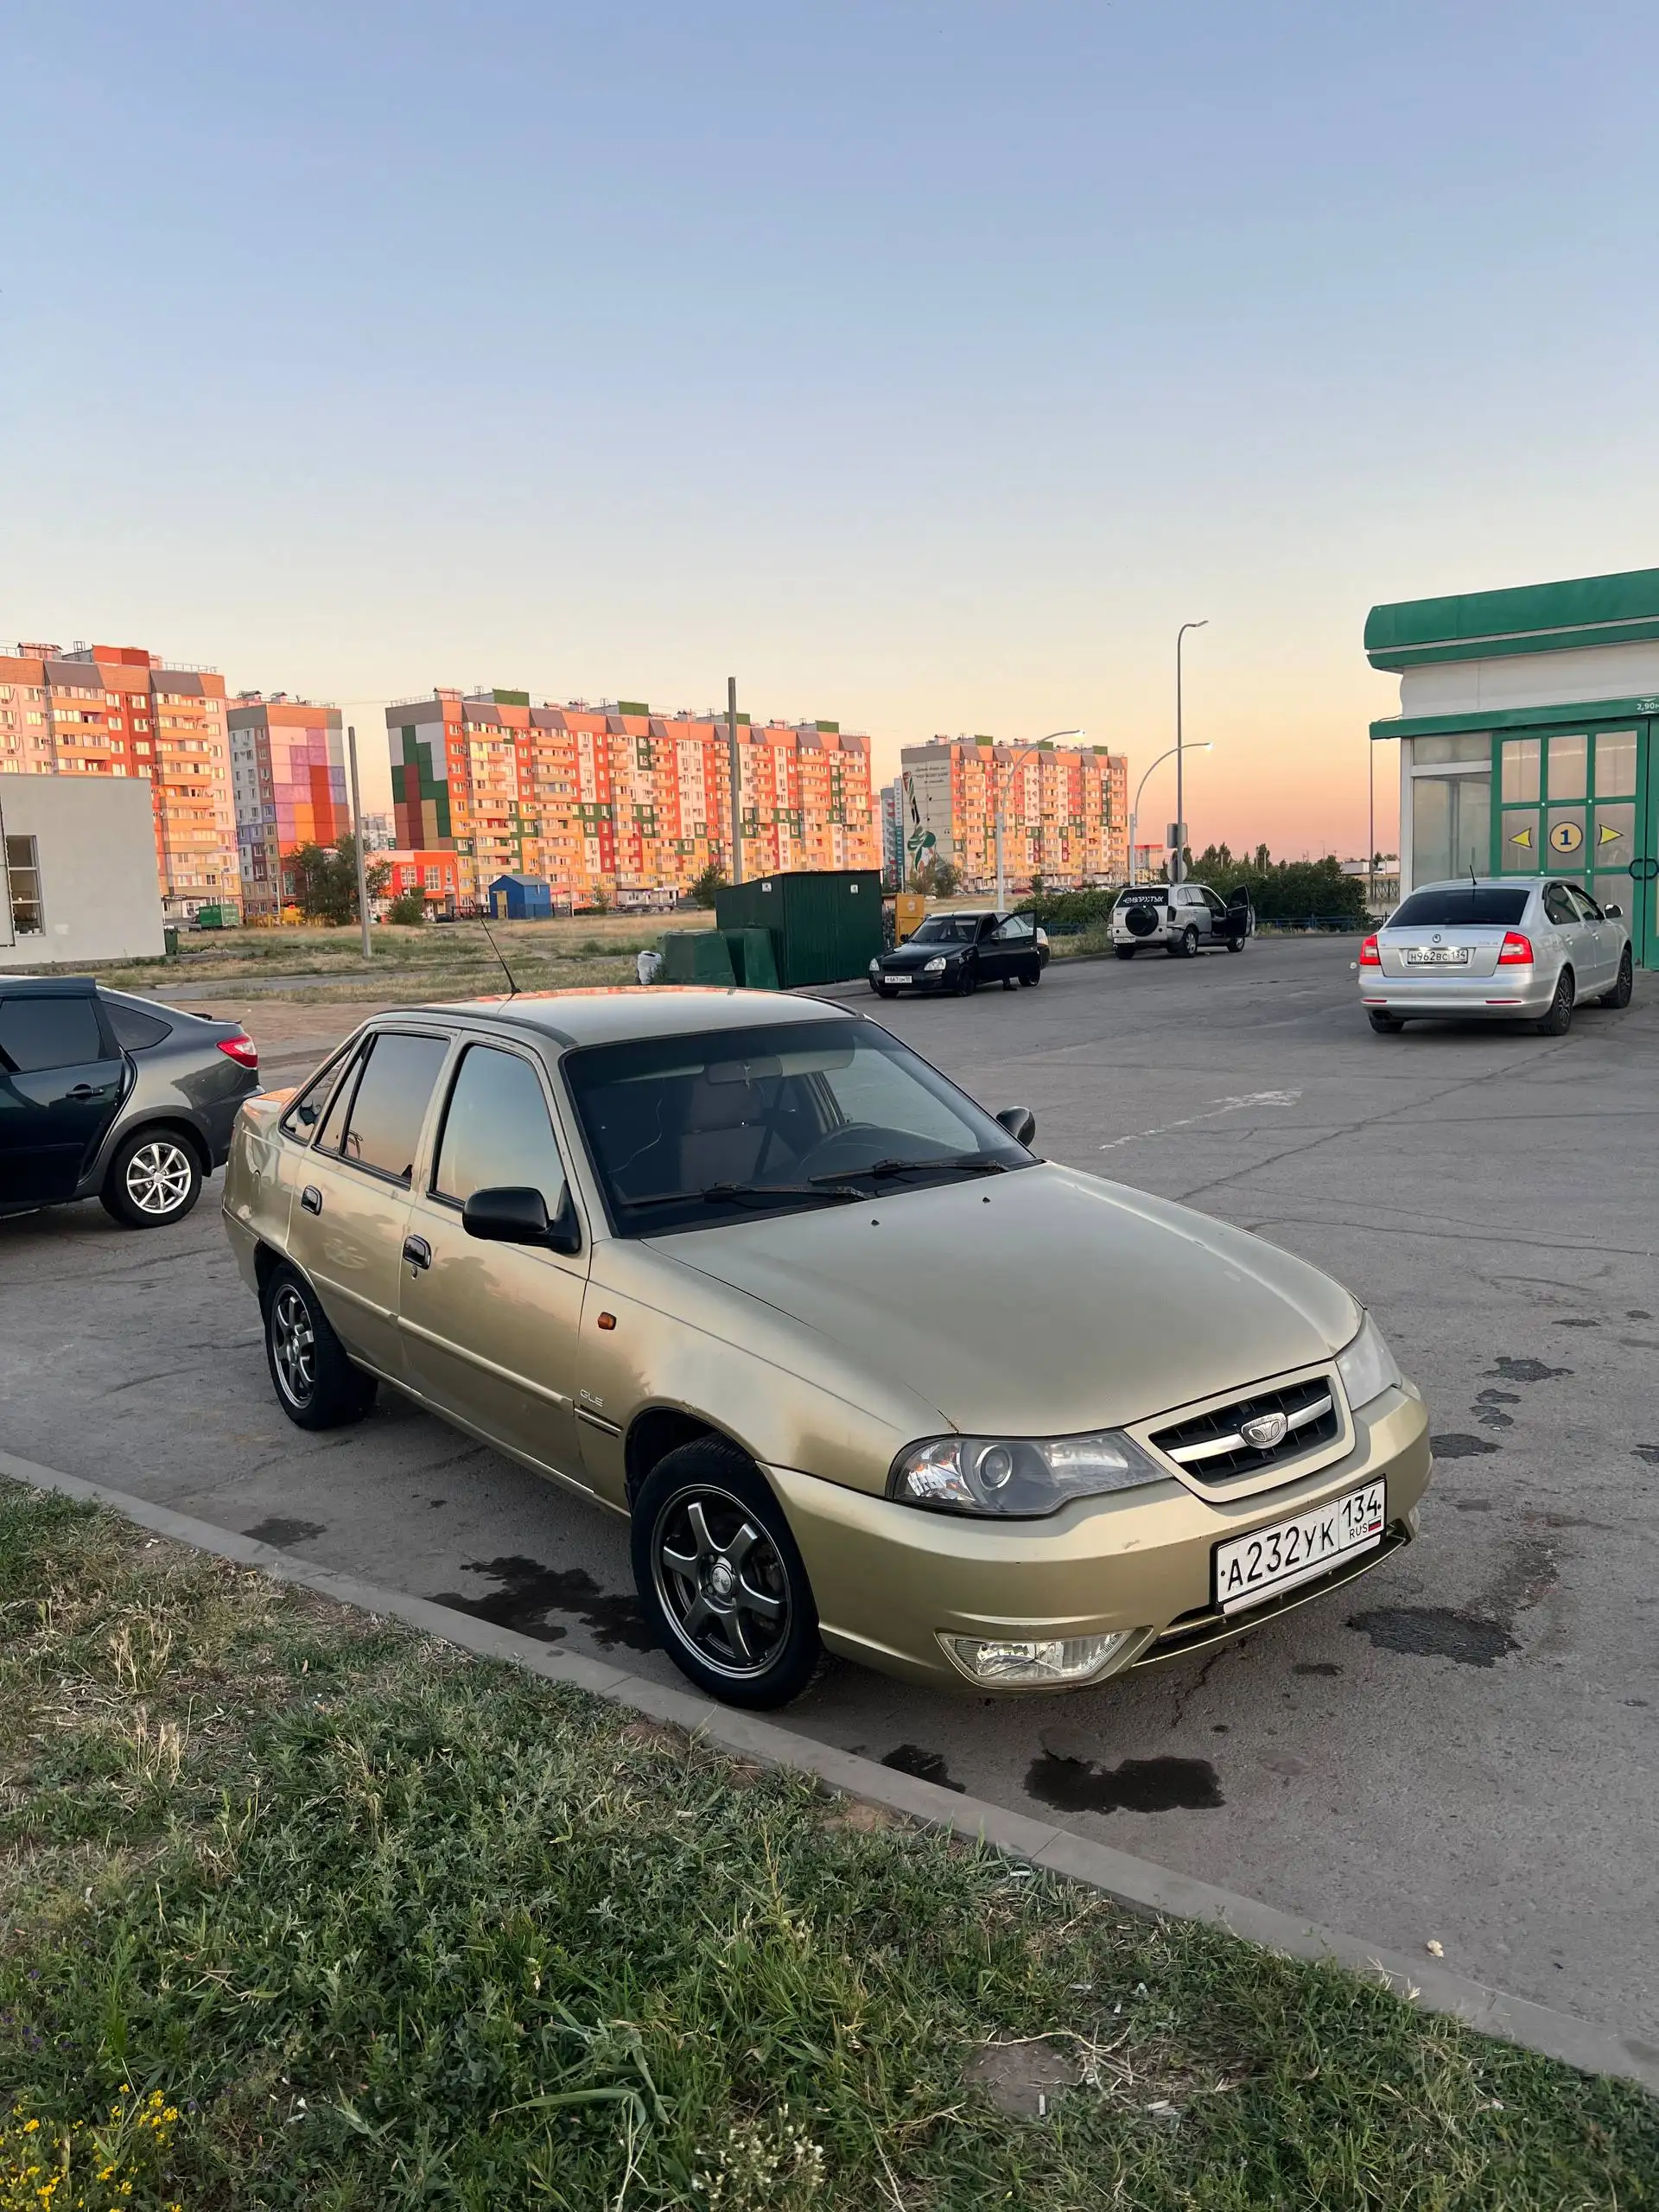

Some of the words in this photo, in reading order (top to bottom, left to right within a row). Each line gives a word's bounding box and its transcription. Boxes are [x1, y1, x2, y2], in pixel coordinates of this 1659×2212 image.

[1560, 829, 1572, 845] 1
[580, 1389, 603, 1407] GLE
[1349, 1523, 1368, 1540] RUS
[1227, 1518, 1334, 1592] А232УК
[1342, 1489, 1378, 1528] 134
